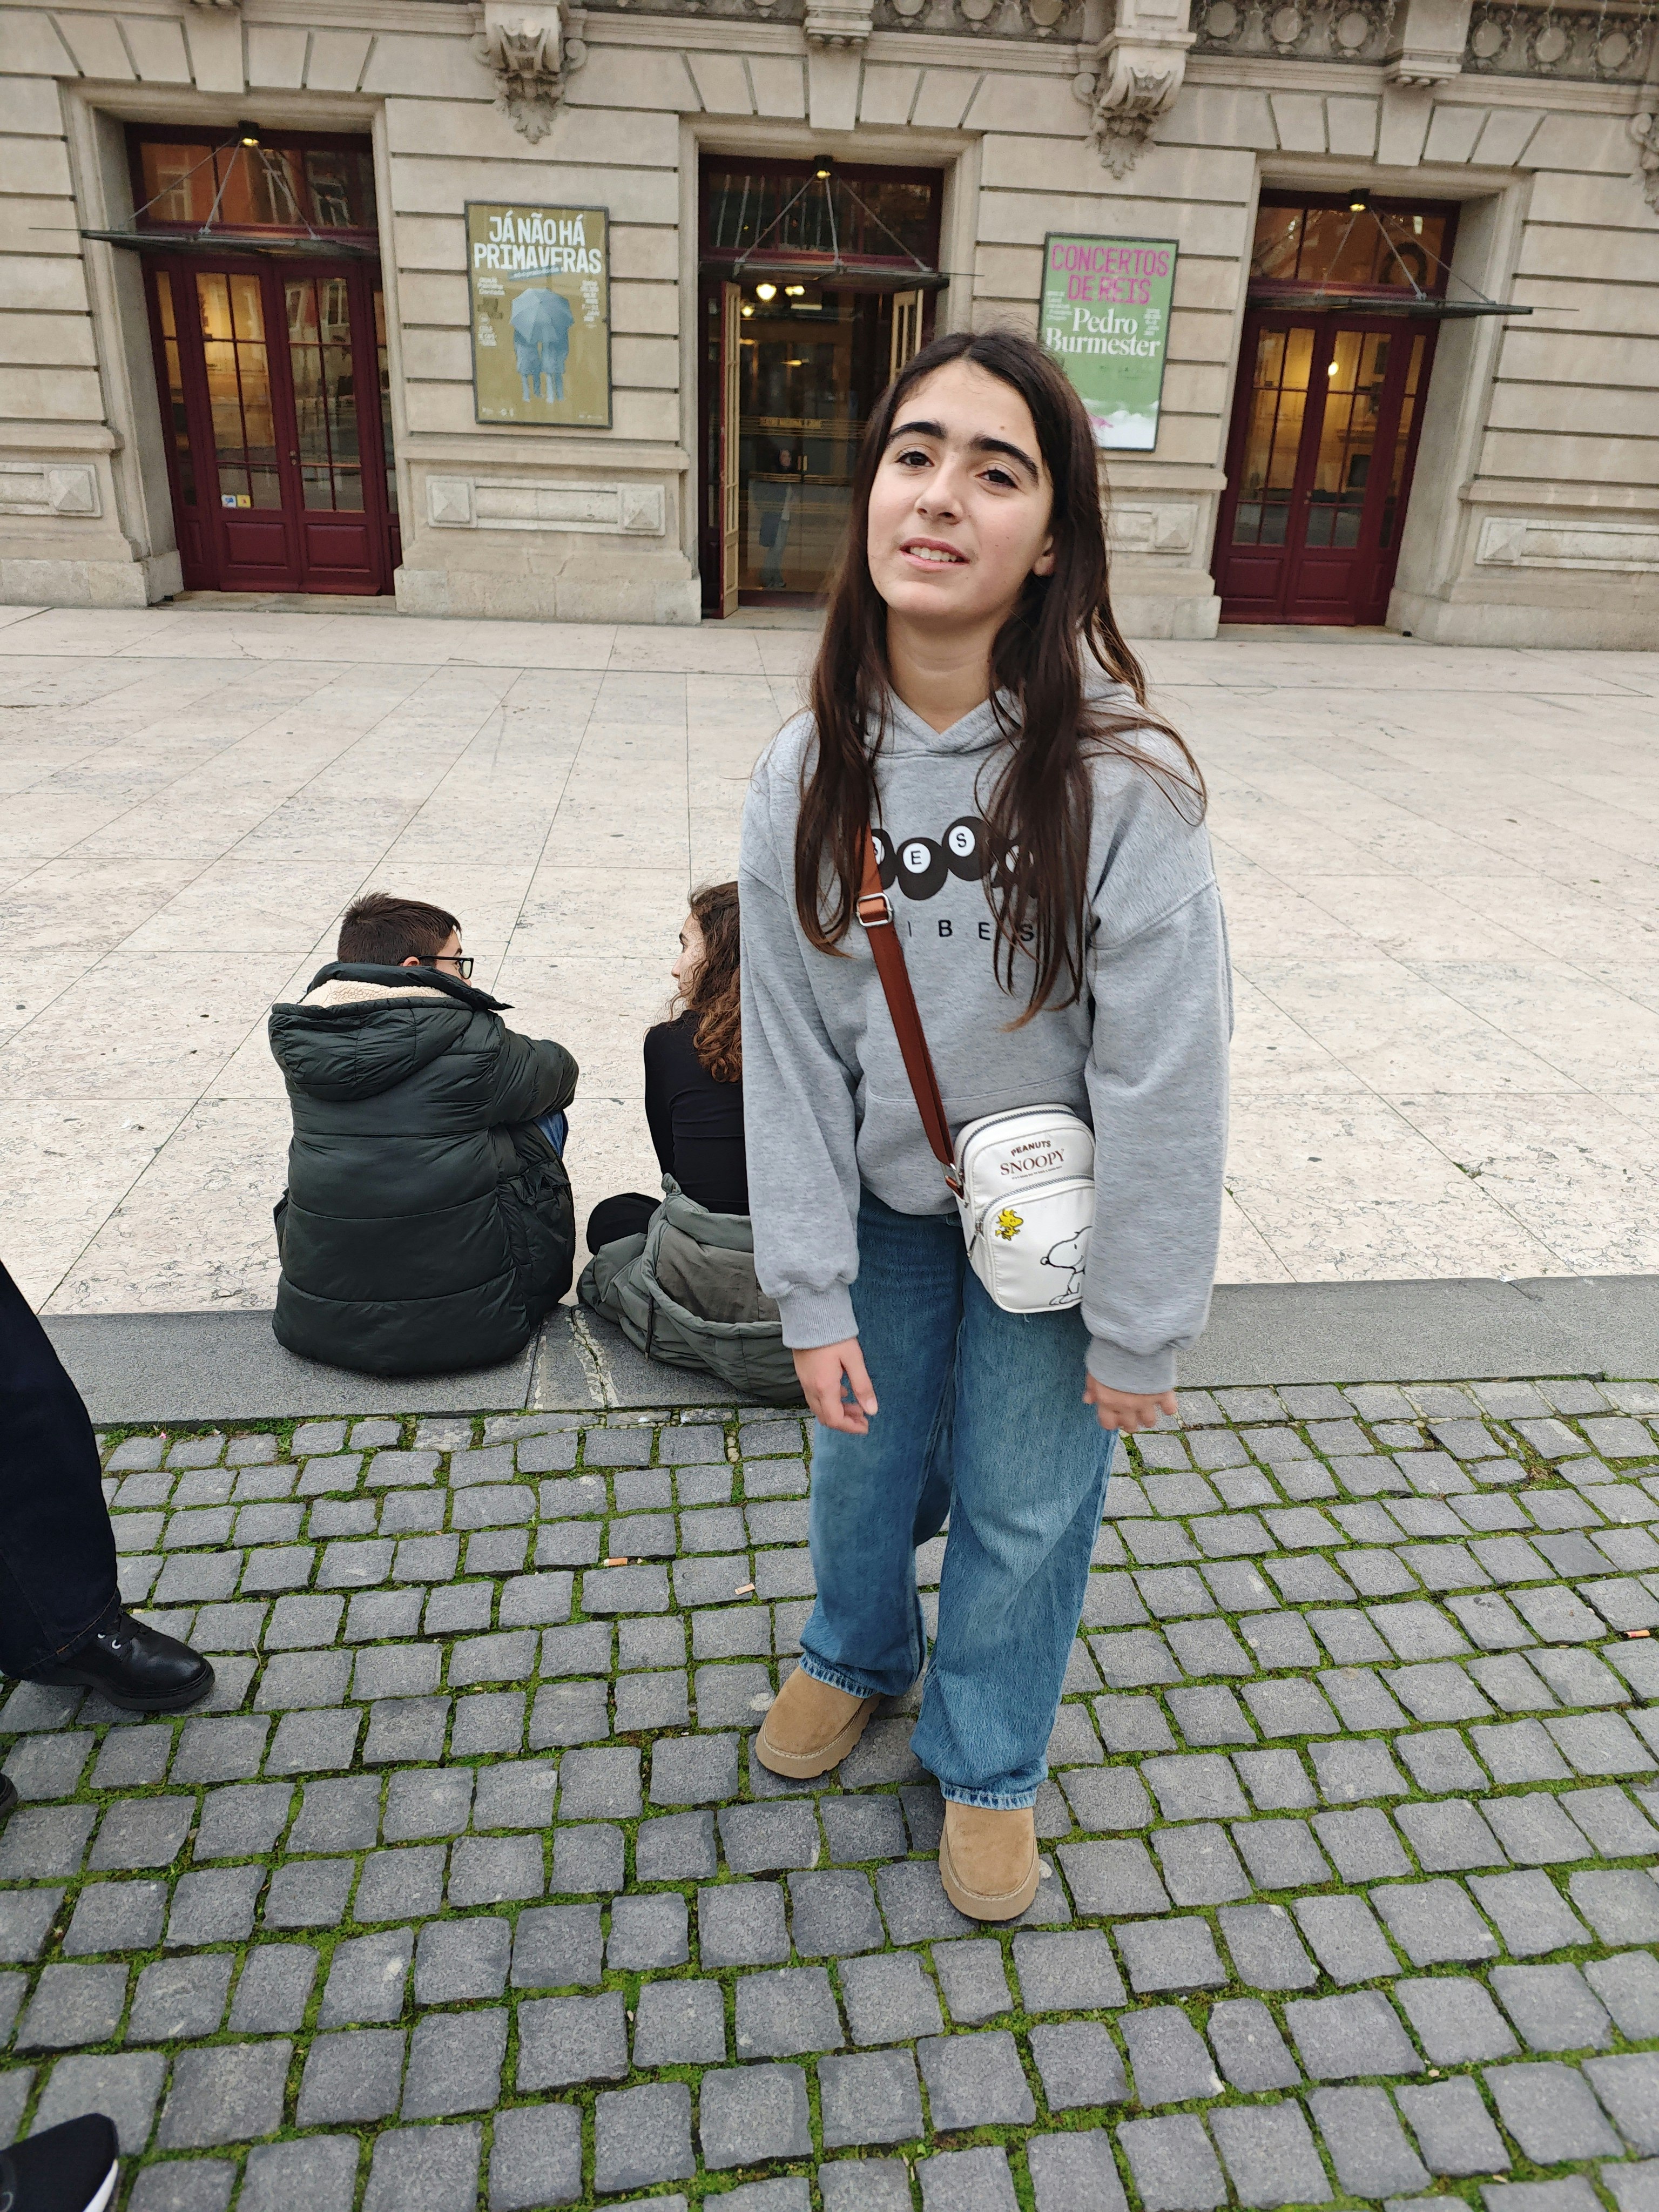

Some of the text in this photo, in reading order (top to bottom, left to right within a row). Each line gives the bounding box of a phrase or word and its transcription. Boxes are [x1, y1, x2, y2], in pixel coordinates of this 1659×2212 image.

[489, 210, 586, 246] JÁ NÃO HÁ
[474, 242, 602, 274] PRIMAVERAS
[1051, 244, 1171, 277] CONCERTOS
[1068, 274, 1152, 305] DE REIS
[1073, 307, 1138, 334] Pedro
[1046, 327, 1161, 356] Burmester
[908, 920, 1034, 941] IBES
[1000, 1148, 1064, 1176] SNOOPY
[1010, 1141, 1051, 1157] PEANUTS
